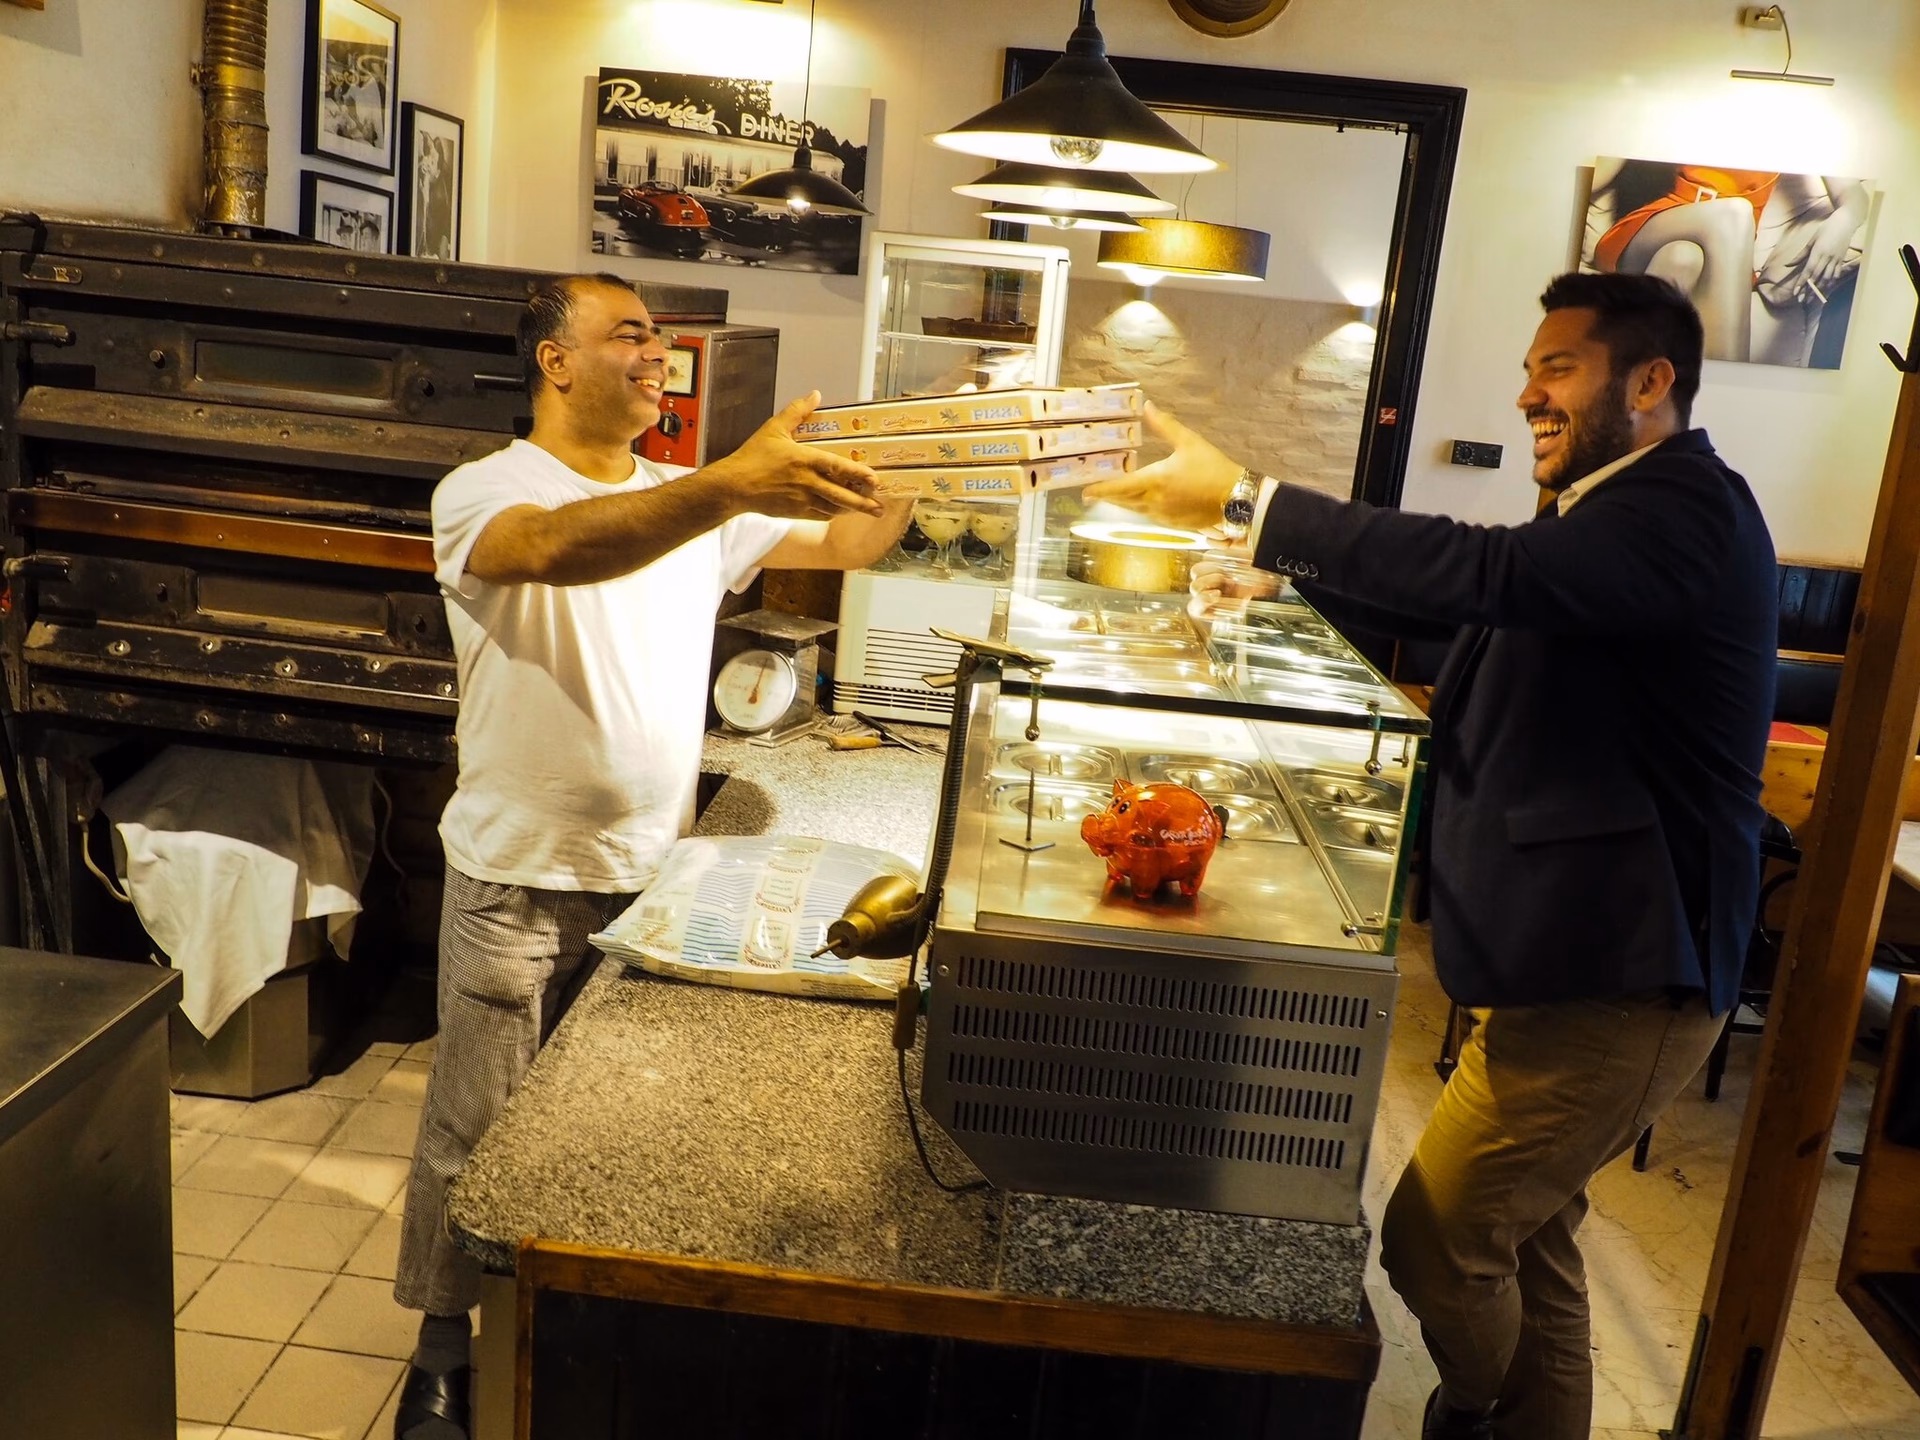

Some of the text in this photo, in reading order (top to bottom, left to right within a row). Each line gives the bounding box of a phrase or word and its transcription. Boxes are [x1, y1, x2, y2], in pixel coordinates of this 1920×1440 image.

[598, 78, 815, 147] Rosie's DINER
[974, 407, 1023, 421] PIZZA
[797, 421, 840, 434] PIZZA
[971, 442, 1020, 456] PIZZA
[965, 478, 1013, 490] PIZZA
